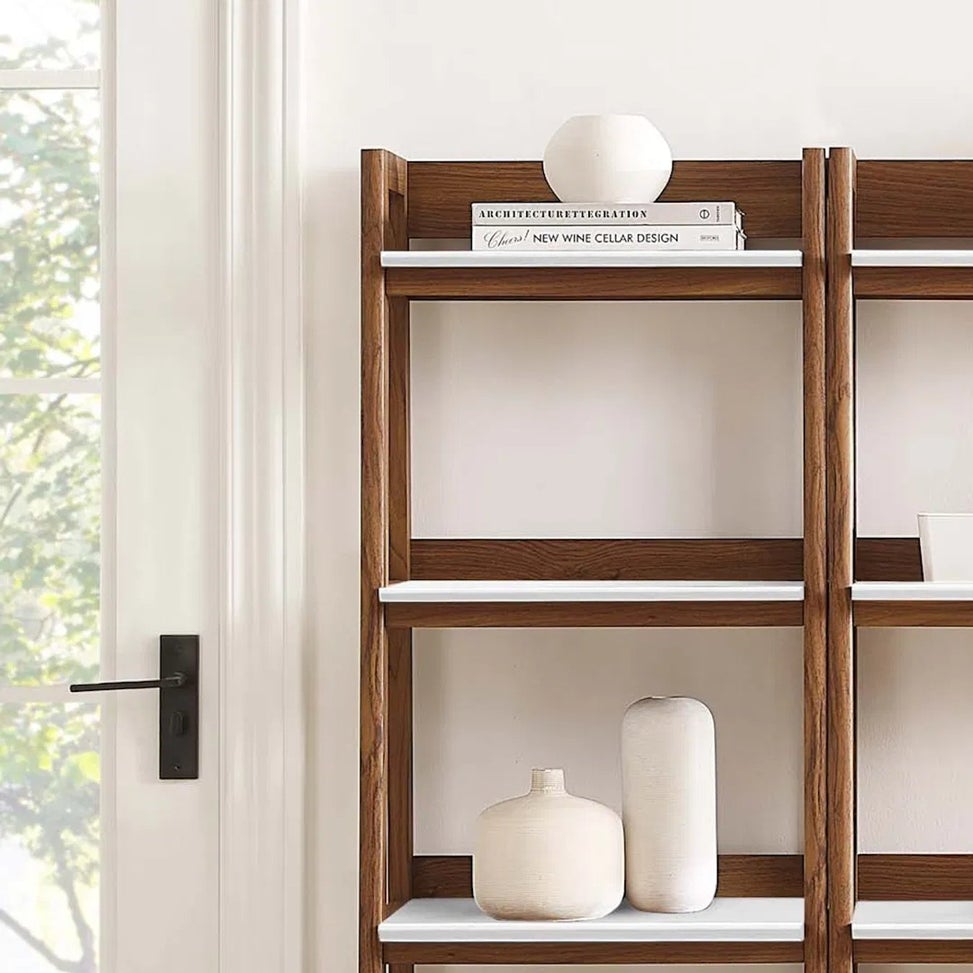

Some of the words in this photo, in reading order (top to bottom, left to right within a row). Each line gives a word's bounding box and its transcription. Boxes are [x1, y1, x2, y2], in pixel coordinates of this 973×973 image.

[479, 210, 648, 218] ARCHITECTURETTEGRATION
[533, 233, 559, 243] NEW
[562, 233, 592, 243] WINE
[594, 233, 634, 243] CELLAR
[637, 233, 679, 243] DESIGN
